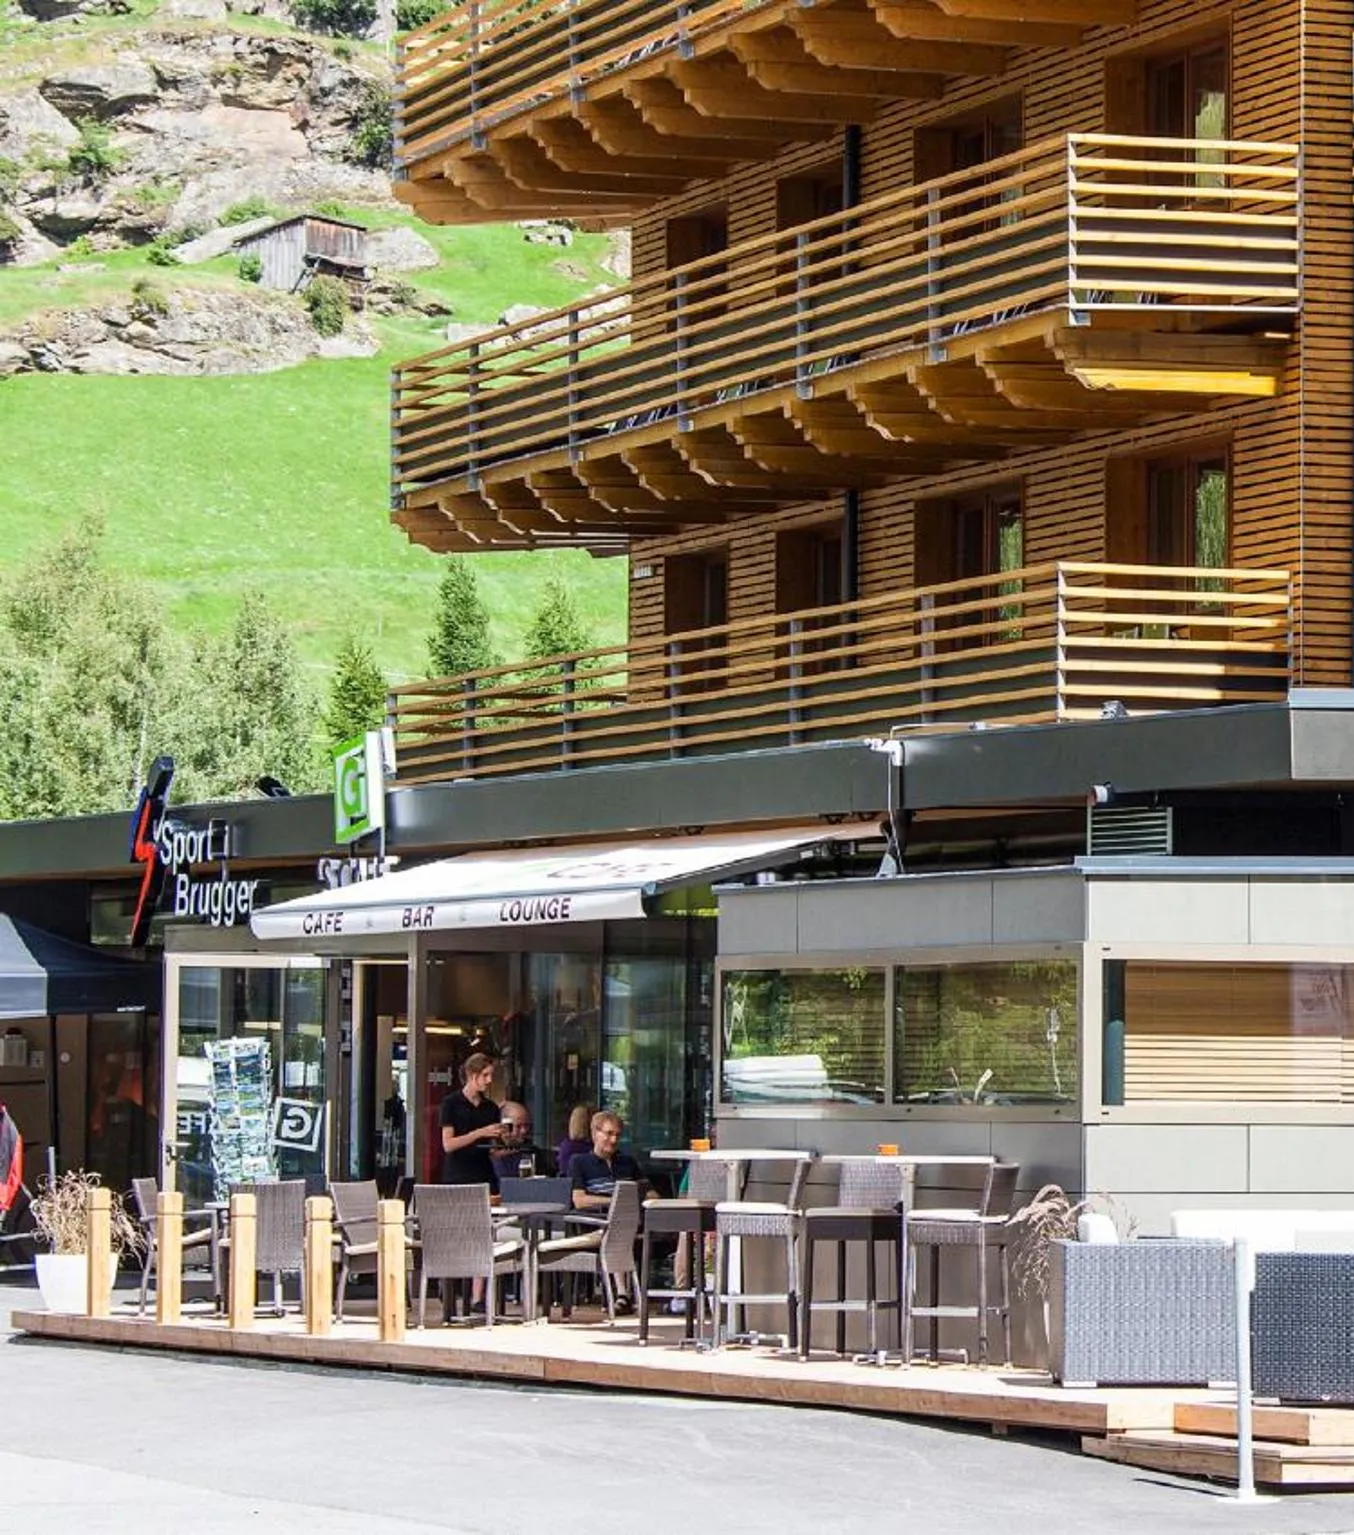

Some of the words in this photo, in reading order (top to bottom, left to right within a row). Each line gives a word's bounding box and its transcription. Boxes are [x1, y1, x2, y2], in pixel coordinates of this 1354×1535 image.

[160, 820, 214, 875] Sport
[175, 873, 257, 927] Brugger
[302, 911, 344, 934] CAFE
[401, 906, 435, 929] BAR
[499, 897, 571, 921] LOUNGE
